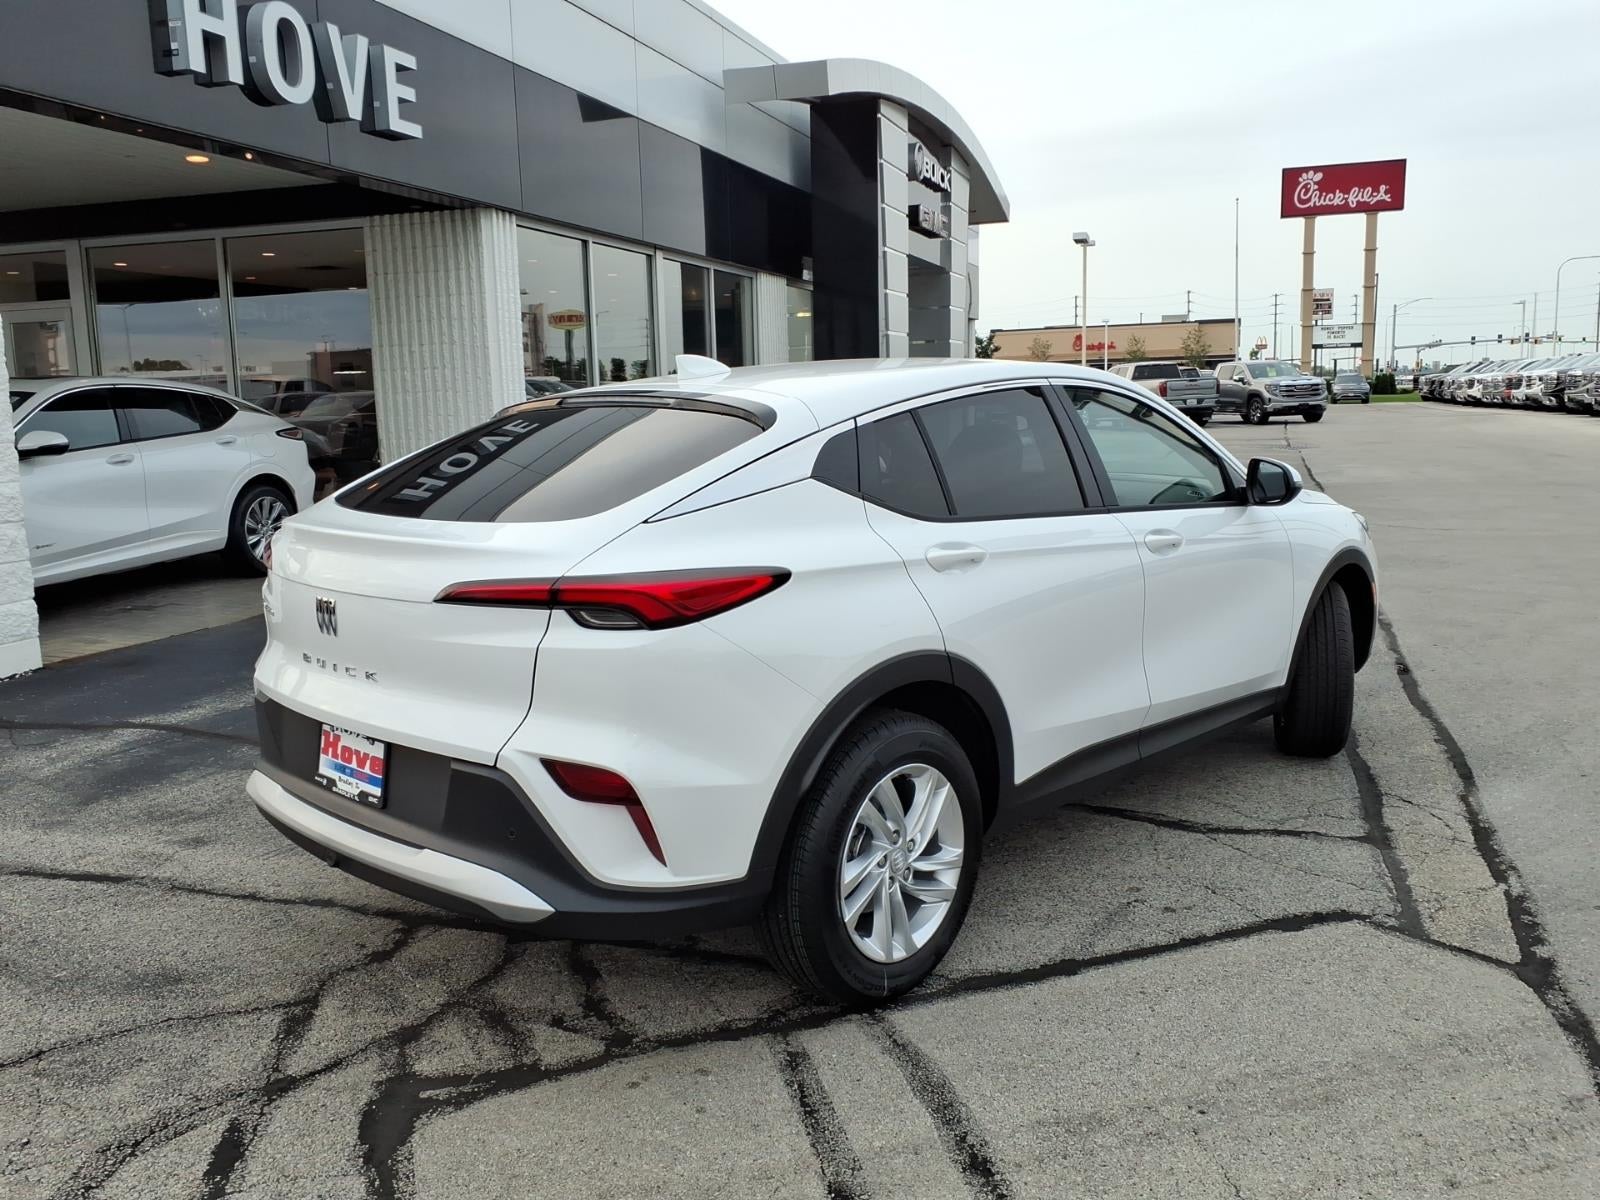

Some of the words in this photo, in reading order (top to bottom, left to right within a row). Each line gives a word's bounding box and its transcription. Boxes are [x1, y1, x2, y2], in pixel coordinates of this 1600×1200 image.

[158, 0, 423, 140] HOVE
[923, 155, 951, 193] BUICK
[1294, 176, 1393, 209] Chick-fil-A
[302, 652, 378, 683] BUICK
[321, 729, 384, 777] Hove
